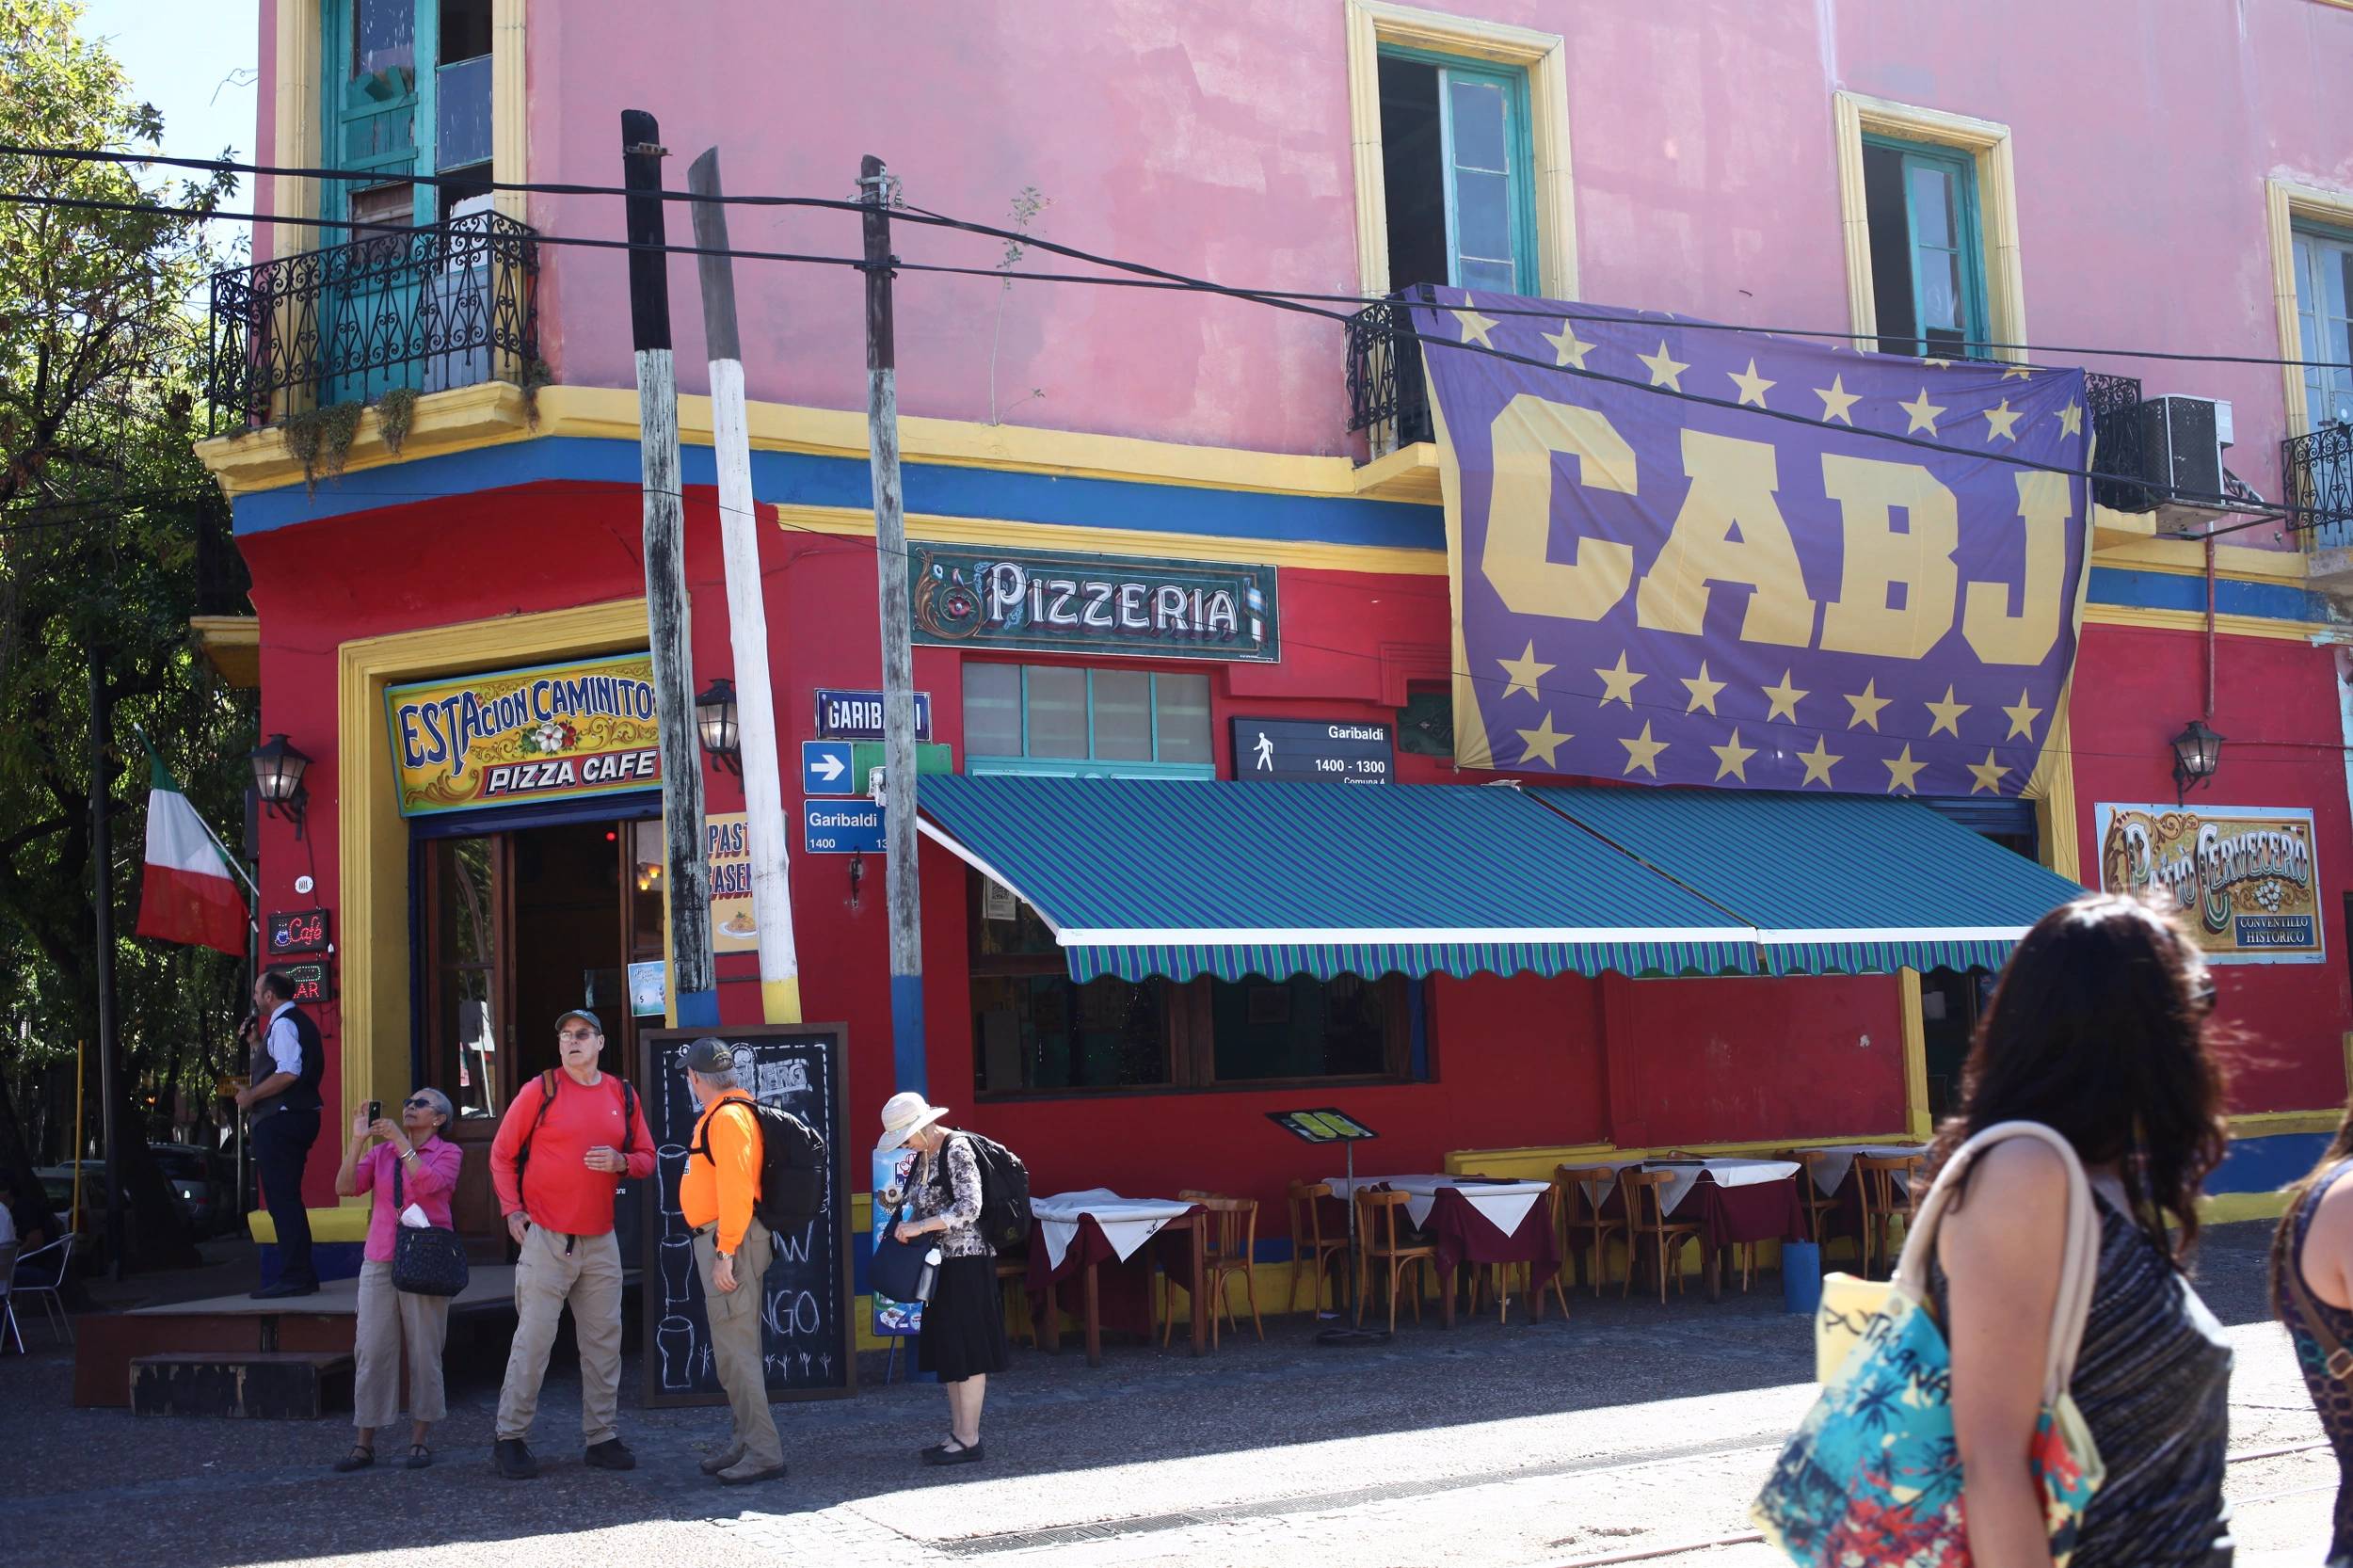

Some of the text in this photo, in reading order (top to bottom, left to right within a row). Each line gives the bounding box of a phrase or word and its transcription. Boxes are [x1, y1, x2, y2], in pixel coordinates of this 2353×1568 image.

[1481, 392, 2073, 666] CABJ
[530, 675, 654, 722] CAMINITO
[828, 700, 921, 730] GARIBI
[1328, 725, 1385, 742] Garibaldi
[485, 748, 658, 796] PIZZA CAFE
[1315, 759, 1345, 772] 1400
[1355, 760, 1385, 774] 1300
[809, 812, 877, 827] Garibaldi
[809, 838, 836, 849] 1400
[289, 915, 322, 946] Café
[2239, 917, 2309, 929] CONVENTILLO
[2246, 930, 2305, 944] HISTORICO
[293, 981, 320, 999] AR
